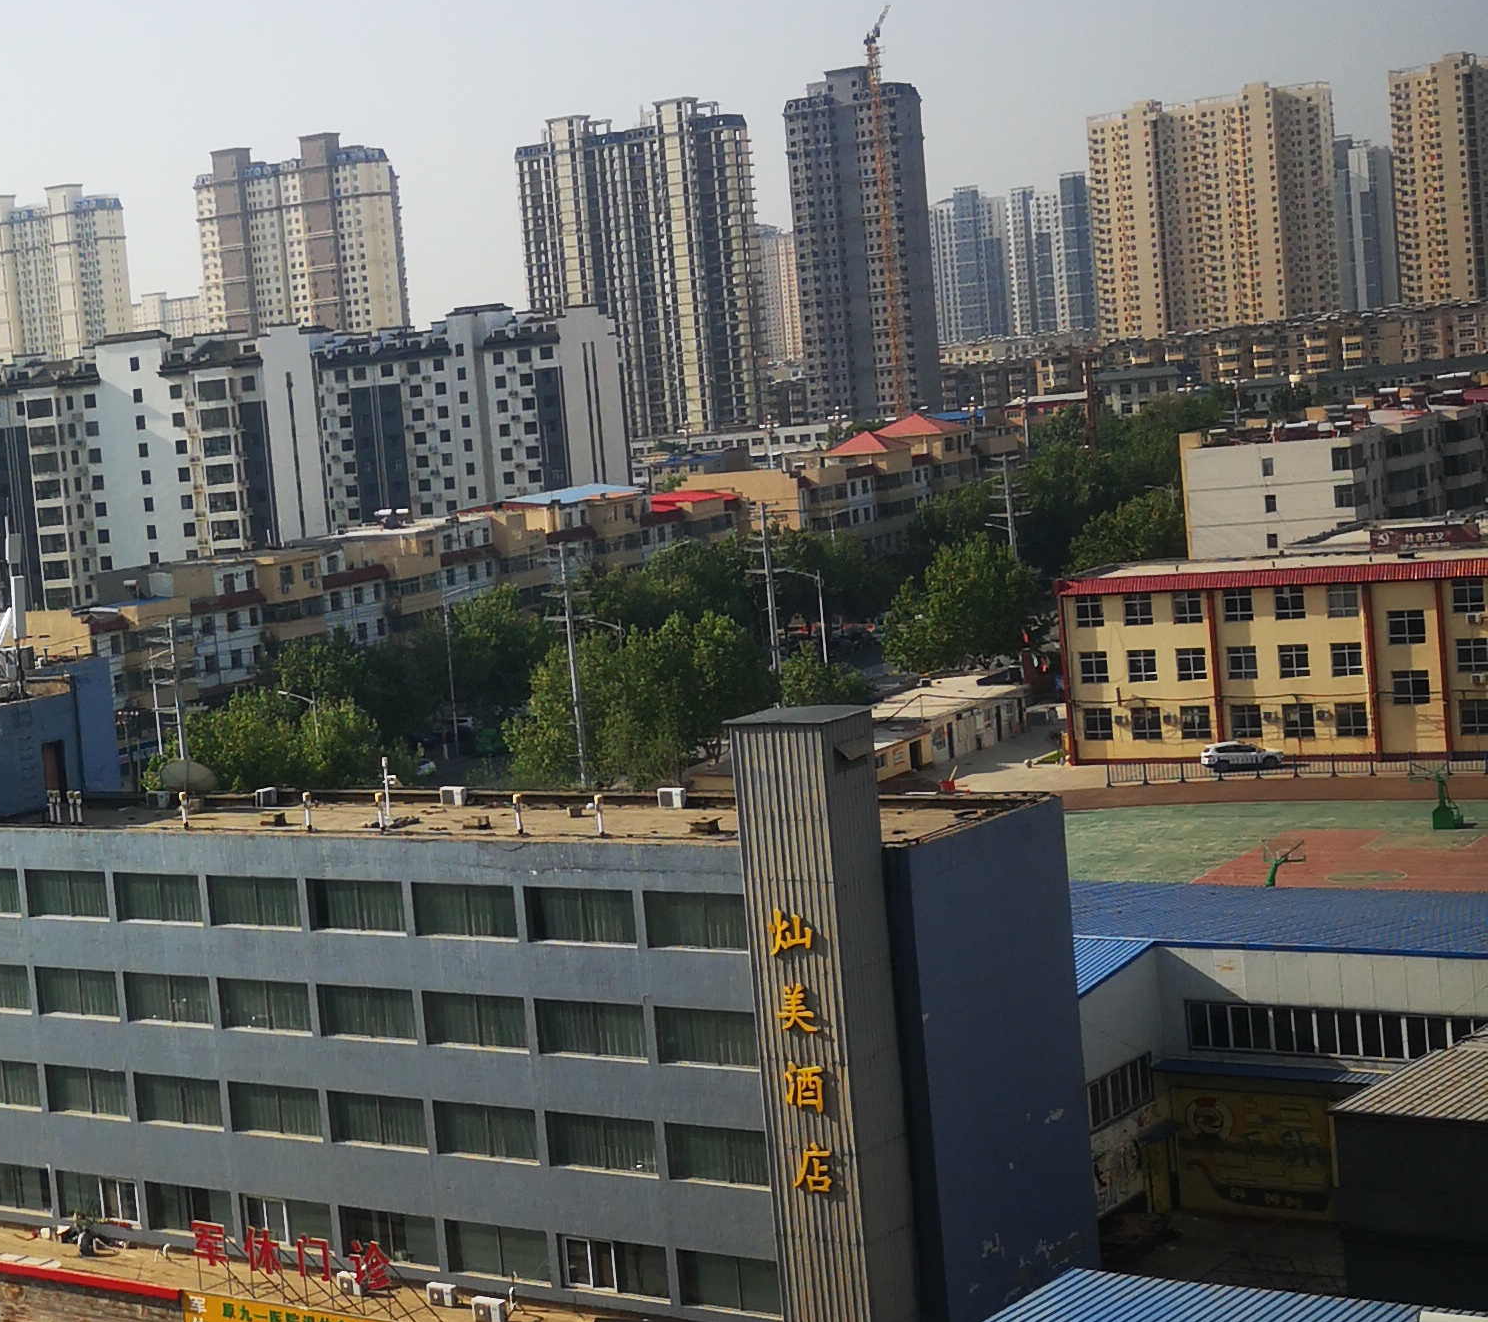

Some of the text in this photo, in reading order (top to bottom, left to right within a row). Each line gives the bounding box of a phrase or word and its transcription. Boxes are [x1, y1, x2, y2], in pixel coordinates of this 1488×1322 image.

[767, 908, 833, 1194] 灿美酒店
[191, 1220, 391, 1290] 军休门诊
